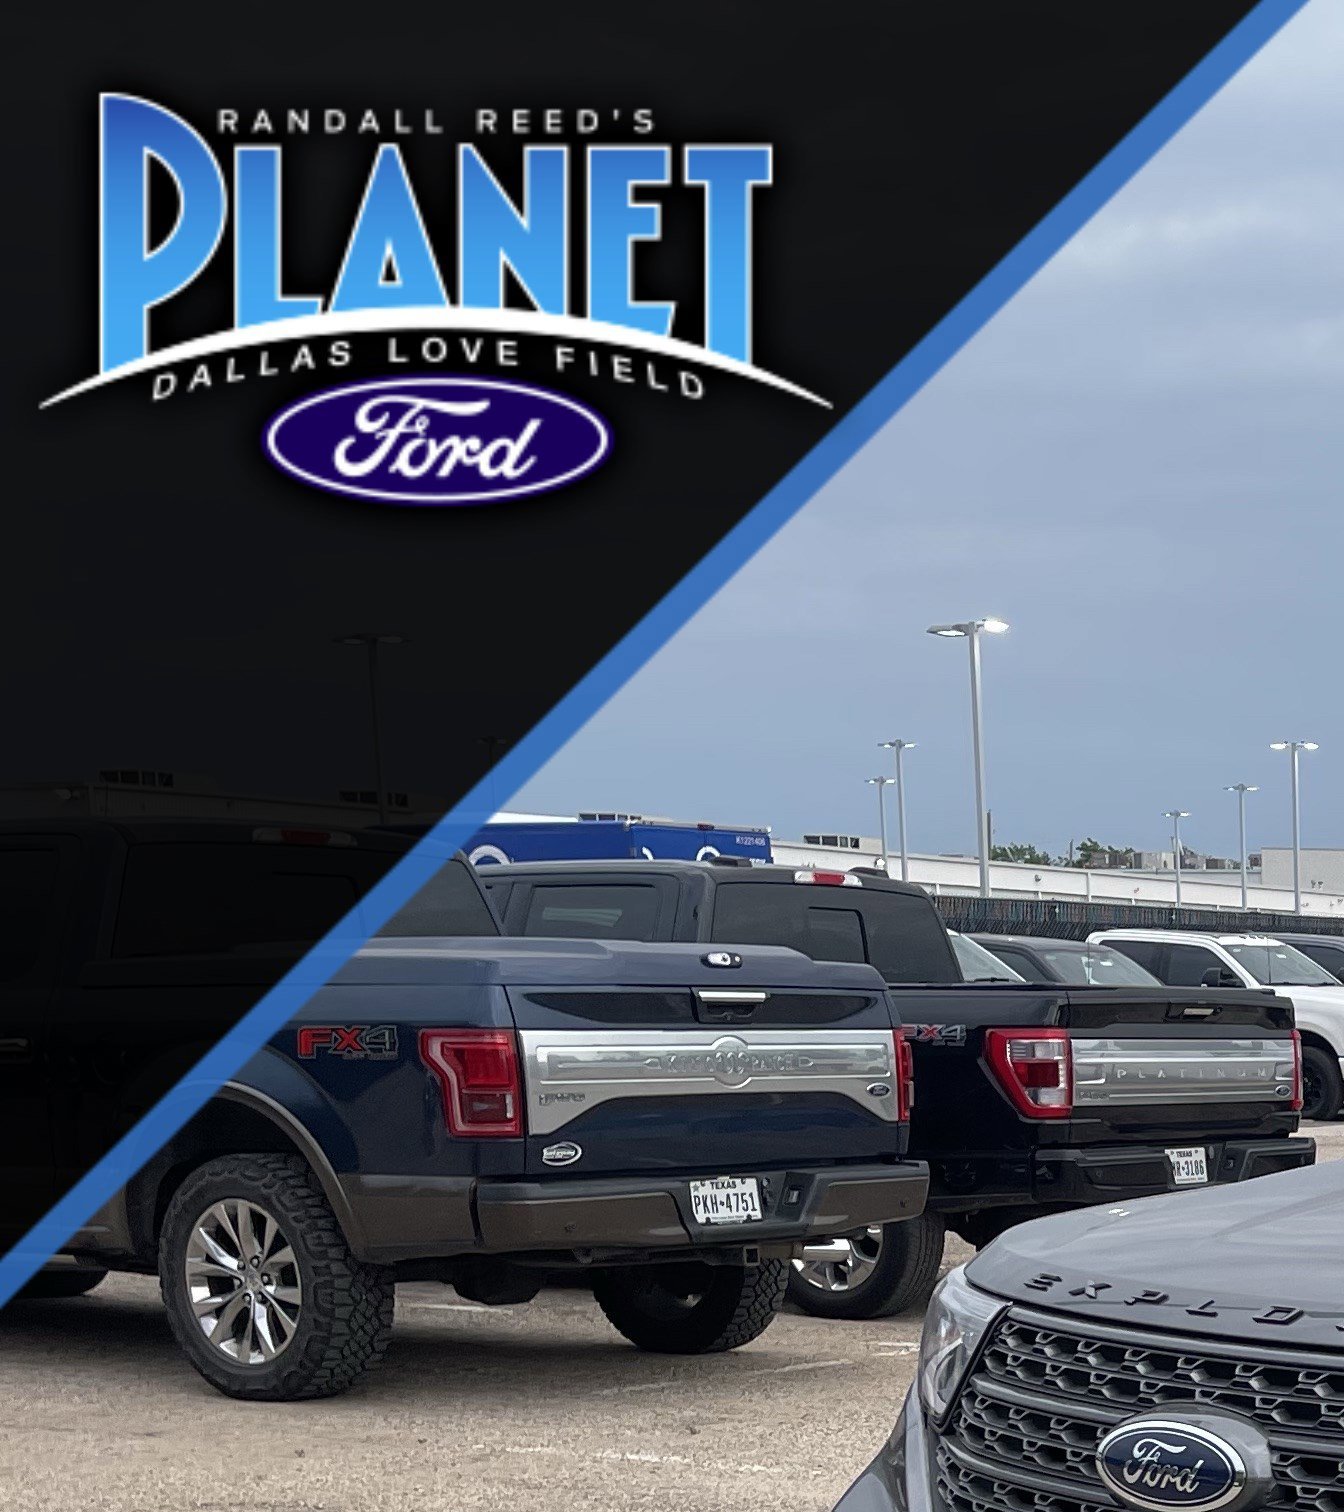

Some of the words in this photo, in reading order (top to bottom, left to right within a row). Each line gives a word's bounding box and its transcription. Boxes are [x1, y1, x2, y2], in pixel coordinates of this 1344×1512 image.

[297, 1024, 398, 1059] FX4
[710, 1181, 736, 1190] TEXAS
[1122, 1438, 1201, 1493] Ford
